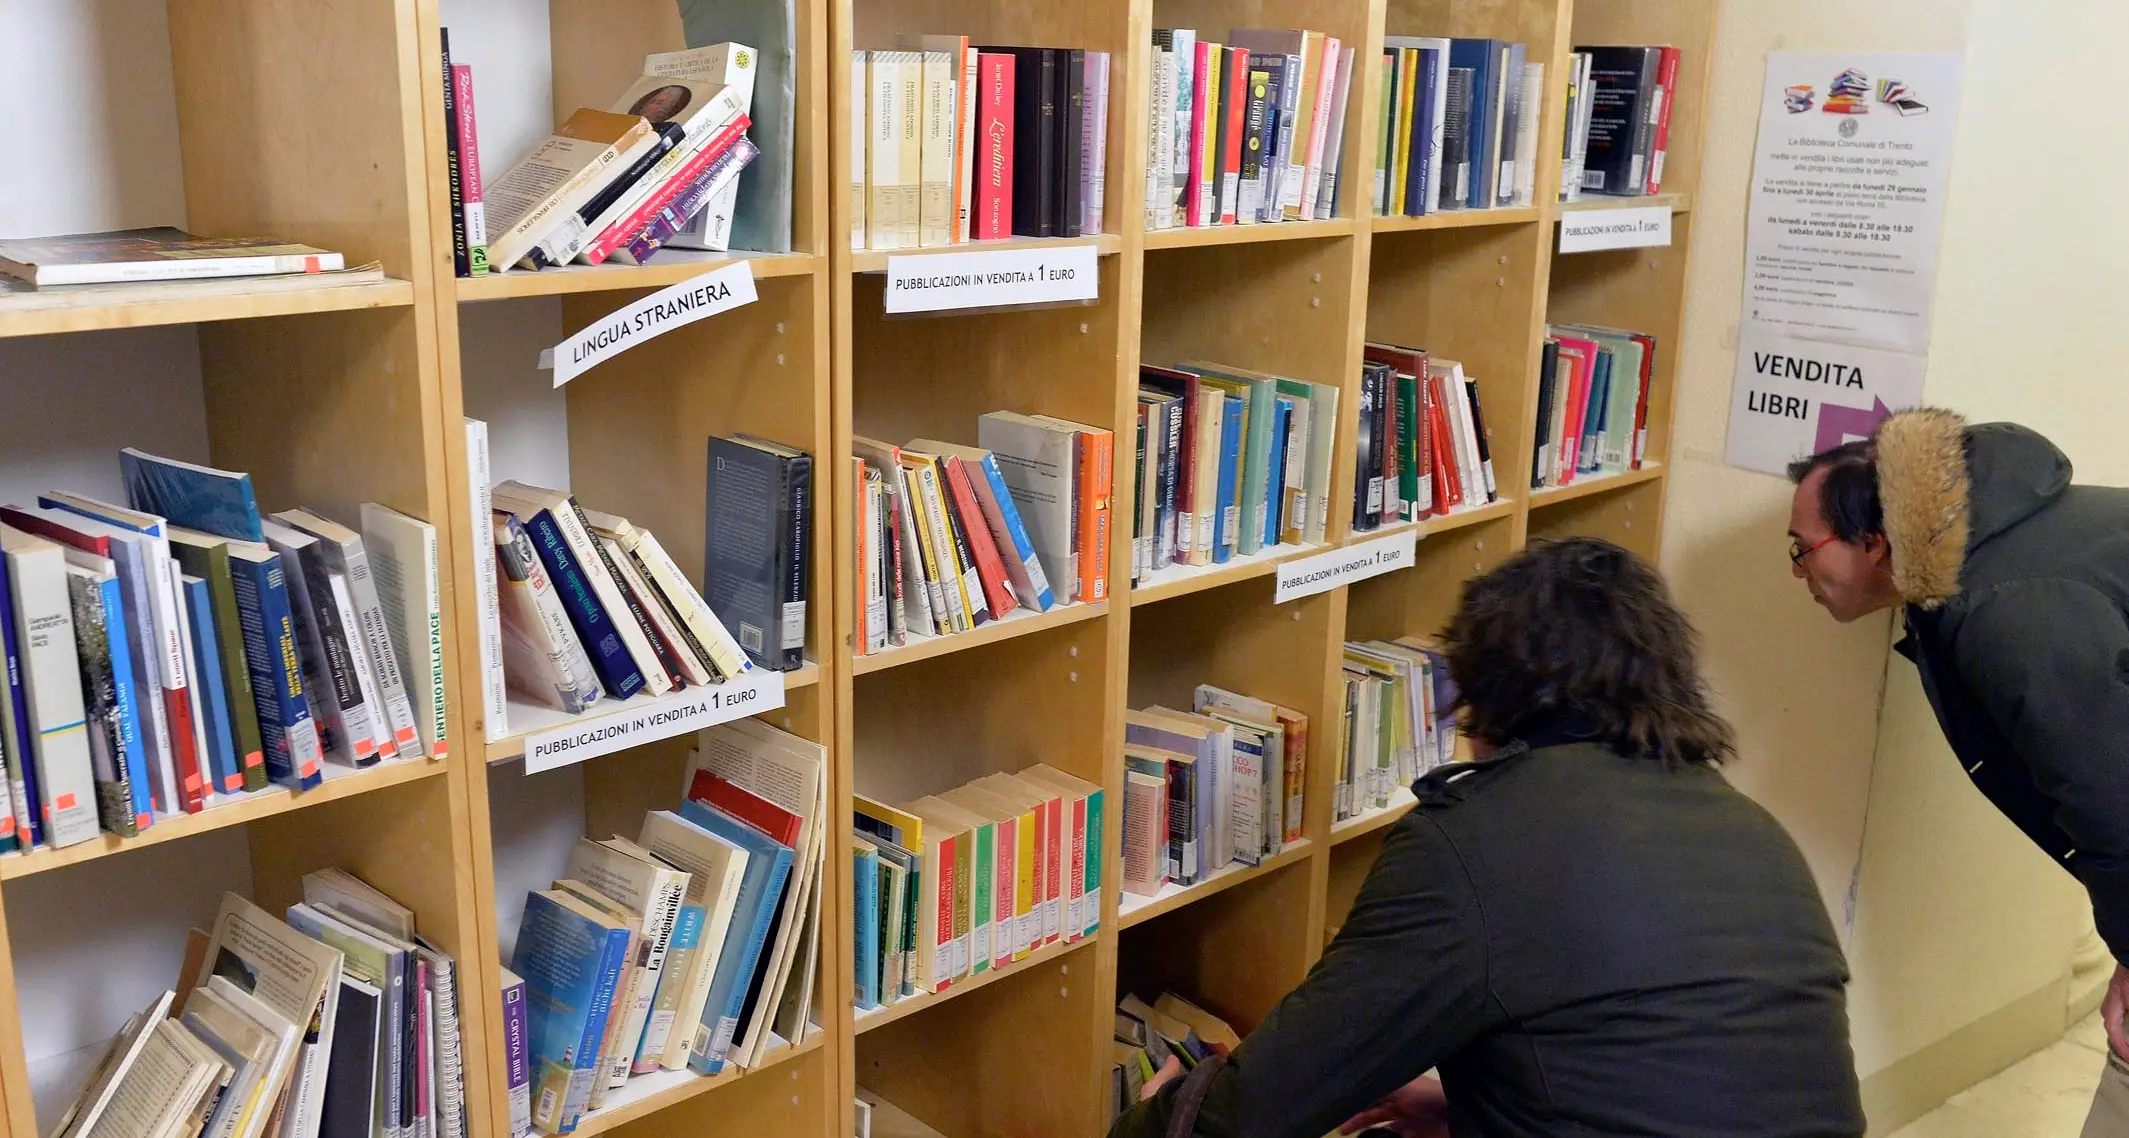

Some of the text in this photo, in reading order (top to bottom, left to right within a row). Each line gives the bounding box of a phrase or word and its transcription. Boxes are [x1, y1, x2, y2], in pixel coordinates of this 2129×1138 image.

[466, 146, 478, 193] EUROPEAN
[986, 117, 1006, 233] L'ereditiera Sonzogno
[1565, 225, 1604, 236] PUBBLICAZIONI
[1611, 223, 1631, 232] VENDITA
[1638, 219, 1642, 231] 1
[1643, 222, 1659, 231] EURO
[896, 264, 1074, 289] PUBBLICAZIONI IN VENDITA A 1 EURO
[574, 282, 731, 363] LINGUA STRANIERA
[1753, 351, 1865, 390] VENDITA
[1747, 390, 1808, 421] LIBRI
[1165, 405, 1179, 448] CUSSLER
[536, 519, 557, 548] Ribeiro
[551, 545, 571, 570] Darcy
[1282, 570, 1331, 588] PUBBLICAZIONI
[1334, 567, 1339, 575] IN
[1342, 560, 1367, 572] VENDITA
[1376, 552, 1379, 563] 1
[1384, 551, 1400, 562] EURO
[363, 611, 374, 632] COLONI
[372, 606, 385, 634] FAZENDAS
[430, 612, 440, 643] PACE
[325, 634, 342, 669] montagne
[370, 638, 382, 659] BIANCHI
[641, 622, 665, 654] POTIGUARA
[377, 659, 388, 680] SCHIAVI
[385, 650, 397, 676] PROGETTO
[432, 647, 442, 684] DELLA
[336, 677, 350, 702] Dentro
[536, 689, 756, 757] PUBBLICAZIONI IN VENDITA A 1 EURO
[648, 882, 671, 937] DESCHAMPS
[647, 882, 686, 972] La Bougainvillée
[680, 911, 695, 944] WHITE
[598, 967, 615, 1012] nicht kalt
[509, 1018, 521, 1057] CRYSTAL
[511, 1059, 521, 1082] BIBLE
